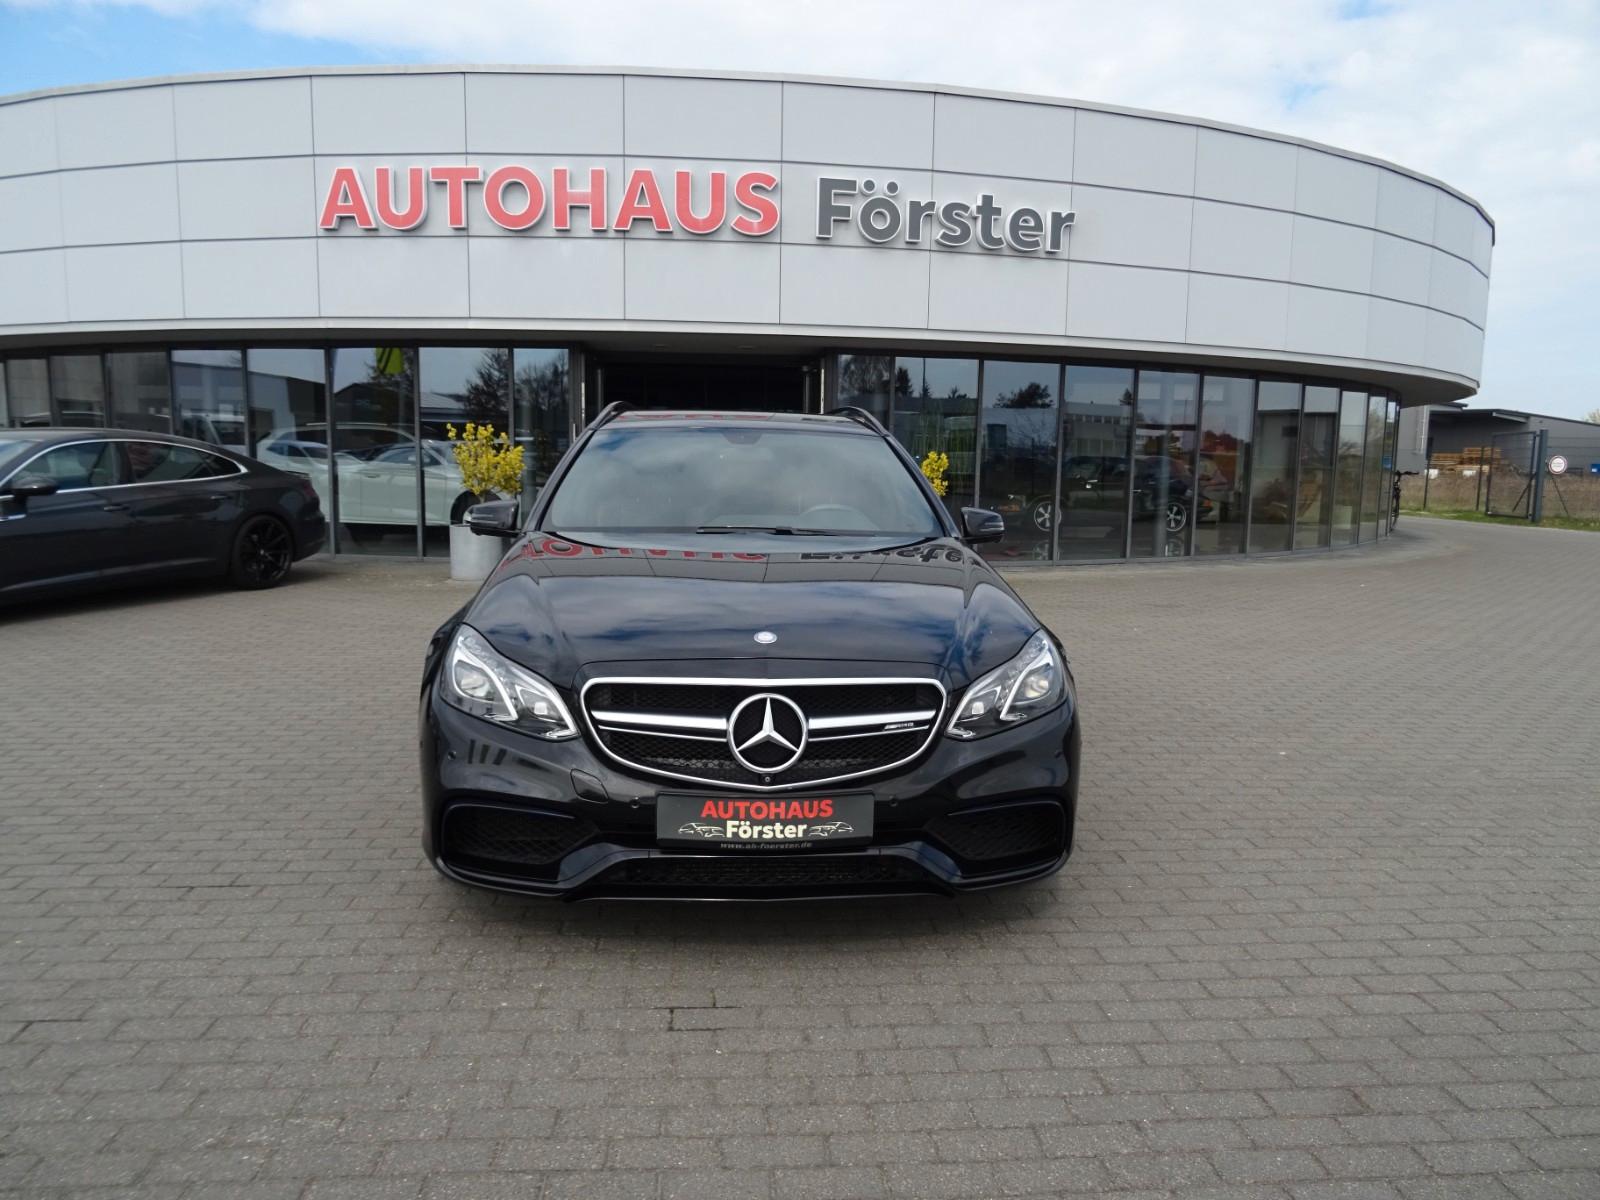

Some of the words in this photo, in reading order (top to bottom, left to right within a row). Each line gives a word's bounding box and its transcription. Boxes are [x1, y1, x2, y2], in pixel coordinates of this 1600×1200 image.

[319, 165, 781, 237] AUTOHAUS
[815, 176, 1076, 255] Förster
[701, 799, 833, 819] AUTOHAUS
[726, 820, 807, 839] Förster
